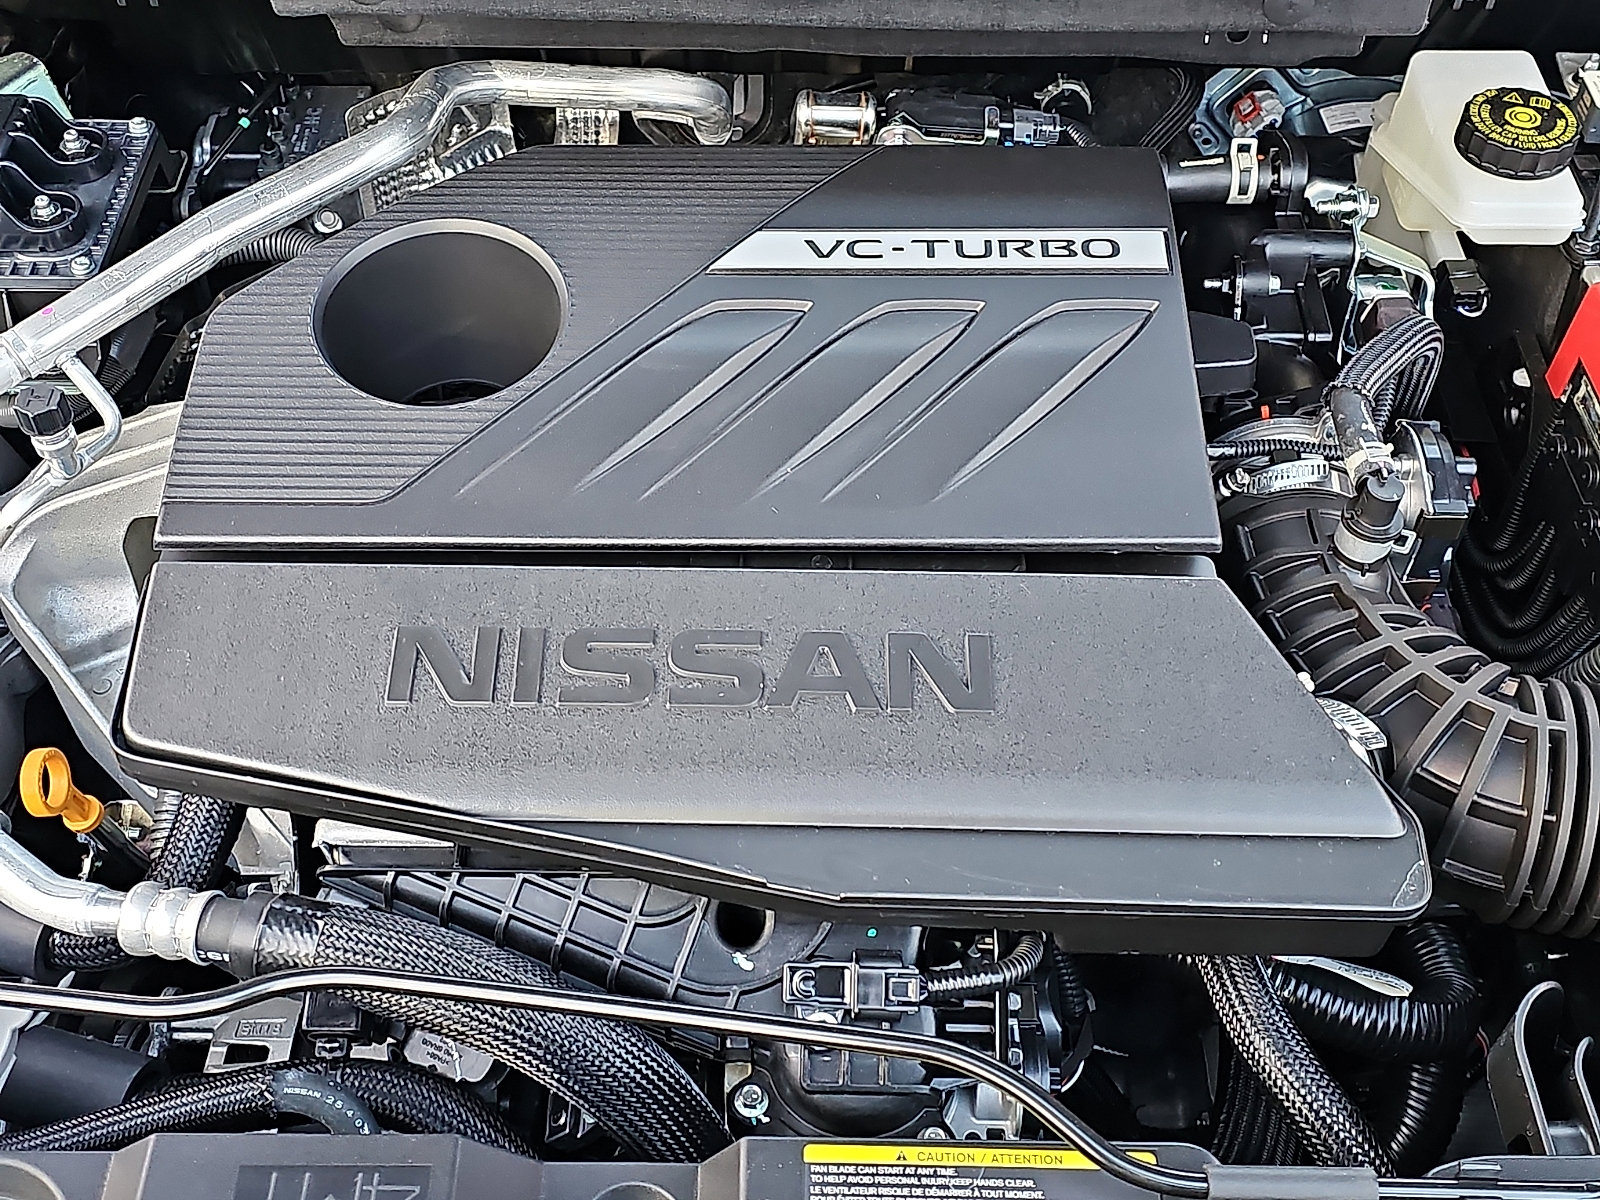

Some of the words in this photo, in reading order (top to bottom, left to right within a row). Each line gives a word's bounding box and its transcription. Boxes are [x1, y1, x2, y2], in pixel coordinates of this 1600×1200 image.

[1488, 131, 1512, 145] BRAKE
[1513, 139, 1537, 149] FLUID
[1501, 130, 1517, 139] CAP
[803, 238, 1121, 259] VC-TURBO
[384, 625, 996, 714] NISSAN
[283, 1087, 322, 1099] NISSAN
[917, 1152, 975, 1163] CAUTION
[991, 1154, 1064, 1165] ATTENTION
[810, 1165, 828, 1173] FAN
[828, 1165, 857, 1174] BLADE
[857, 1166, 877, 1174] CAN
[877, 1166, 904, 1175] START
[905, 1167, 915, 1175] AT
[916, 1167, 935, 1175] ANY
[936, 1168, 958, 1176] TIME.
[810, 1175, 823, 1183] TO
[824, 1175, 847, 1183] HELP
[847, 1175, 874, 1184] AVOID
[874, 1176, 921, 1185] PERSONAL
[951, 1178, 973, 1186] KEEP
[974, 1178, 1004, 1187] HANDS
[1005, 1179, 1036, 1188] CLEAR.
[809, 1186, 822, 1194] LE
[822, 1186, 878, 1195] VENTILATEUR
[878, 1187, 911, 1196] RISQUE
[911, 1188, 924, 1196] DE
[925, 1187, 973, 1197] DÉMARRER
[973, 1187, 981, 1197] À
[981, 1189, 1005, 1198] TOUT
[1005, 1190, 1045, 1199] MOMENT.
